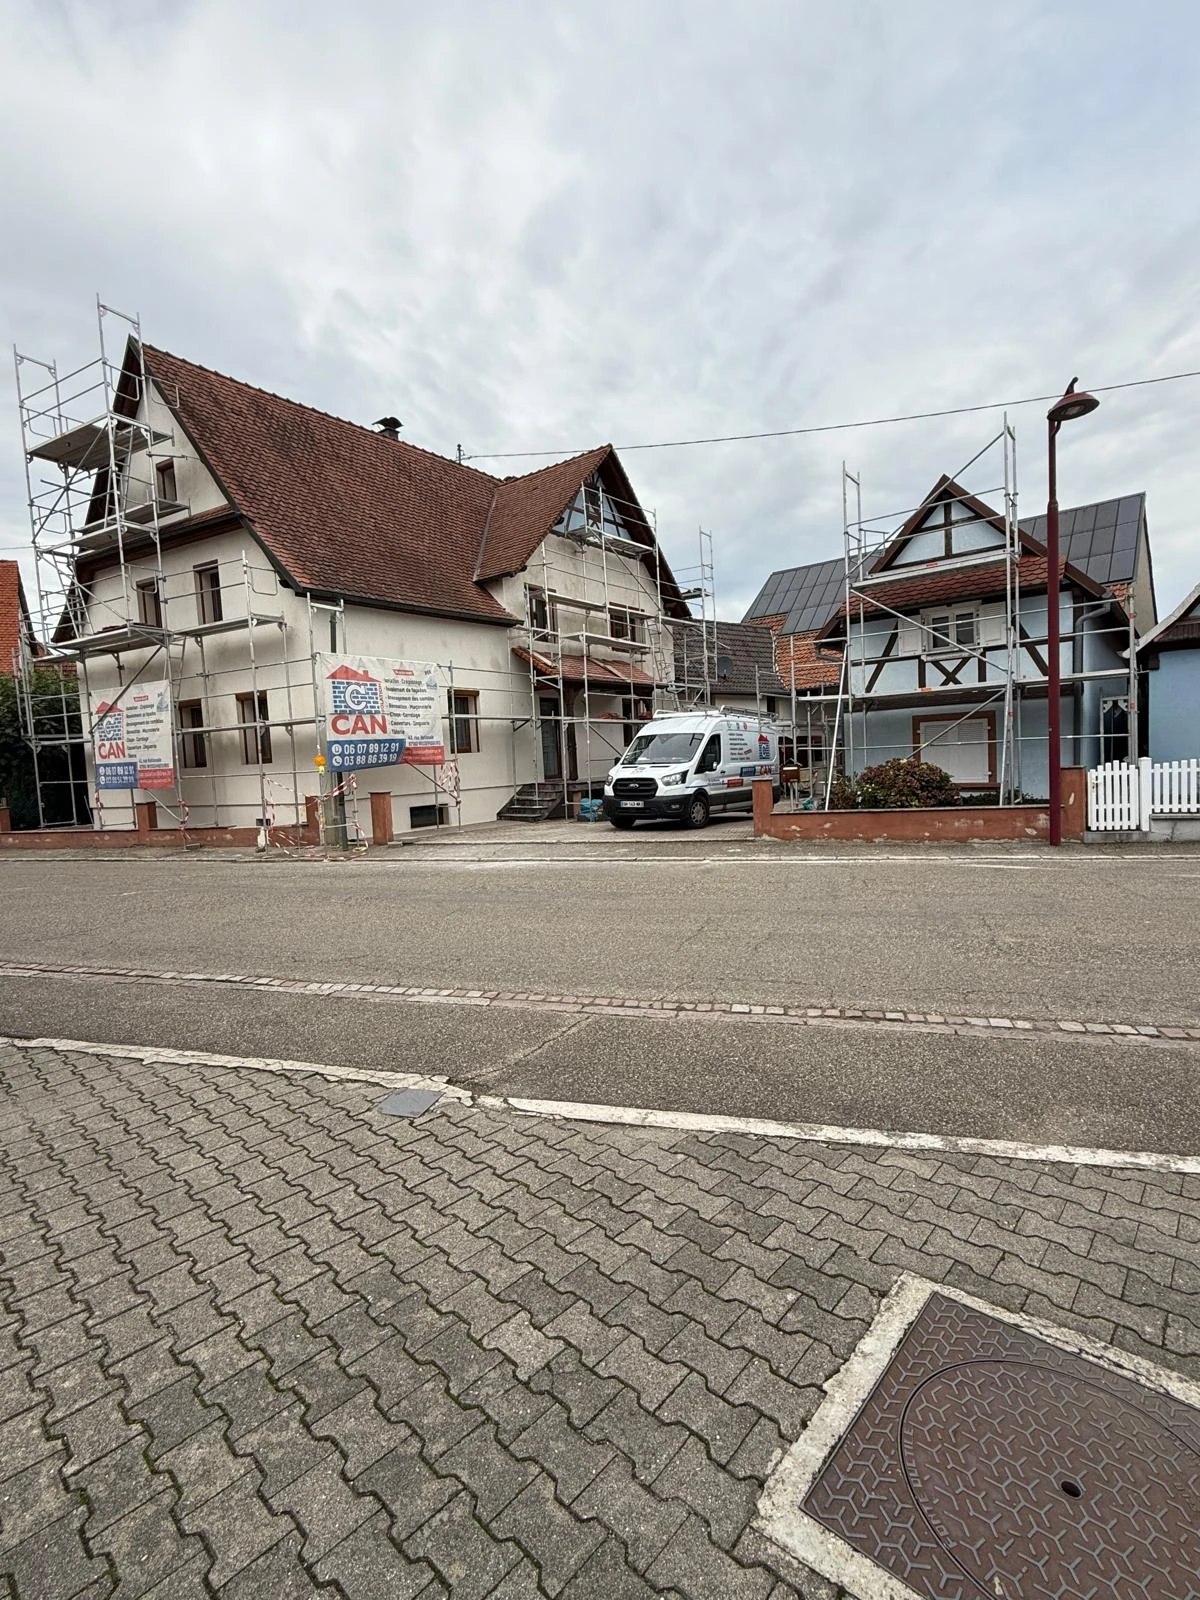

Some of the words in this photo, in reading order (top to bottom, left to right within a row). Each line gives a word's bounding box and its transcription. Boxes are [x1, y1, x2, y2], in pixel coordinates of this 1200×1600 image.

[331, 714, 388, 735] CAN
[98, 741, 126, 759] CAN
[344, 744, 356, 755] 06
[357, 743, 367, 754] 07
[369, 743, 379, 753] 89
[380, 742, 390, 752] 12
[391, 742, 399, 752] 91
[344, 755, 355, 766] 03
[356, 754, 366, 765] 88
[379, 753, 388, 763] 39
[903, 1428, 923, 1488] DUCTILE
